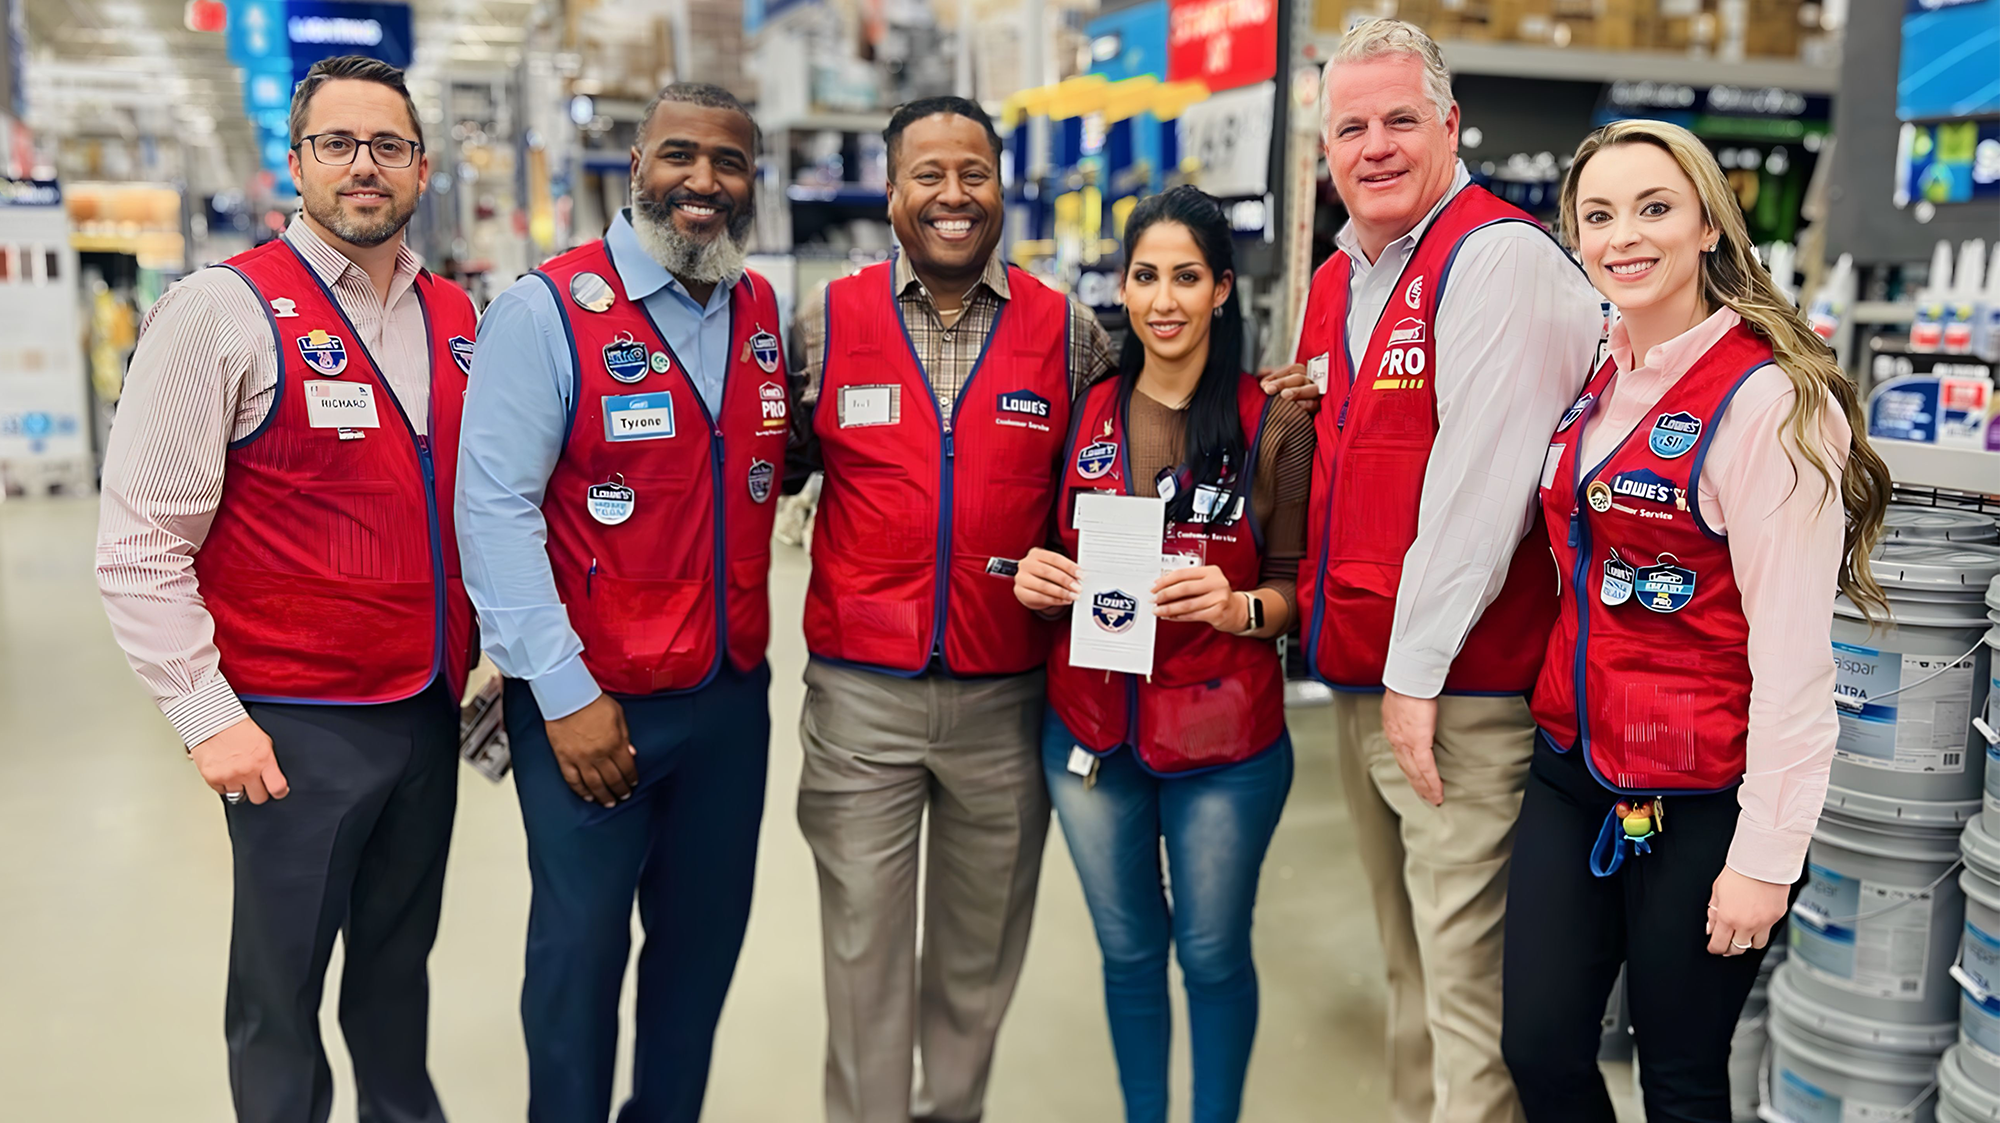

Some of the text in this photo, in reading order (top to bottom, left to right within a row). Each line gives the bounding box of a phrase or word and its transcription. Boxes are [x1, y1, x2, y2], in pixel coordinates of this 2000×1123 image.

[1377, 347, 1425, 377] PRO
[762, 401, 786, 418] PRO
[1002, 396, 1048, 416] LOWE'S
[620, 417, 662, 431] Tyrone
[1613, 475, 1670, 502] LOWE'S
